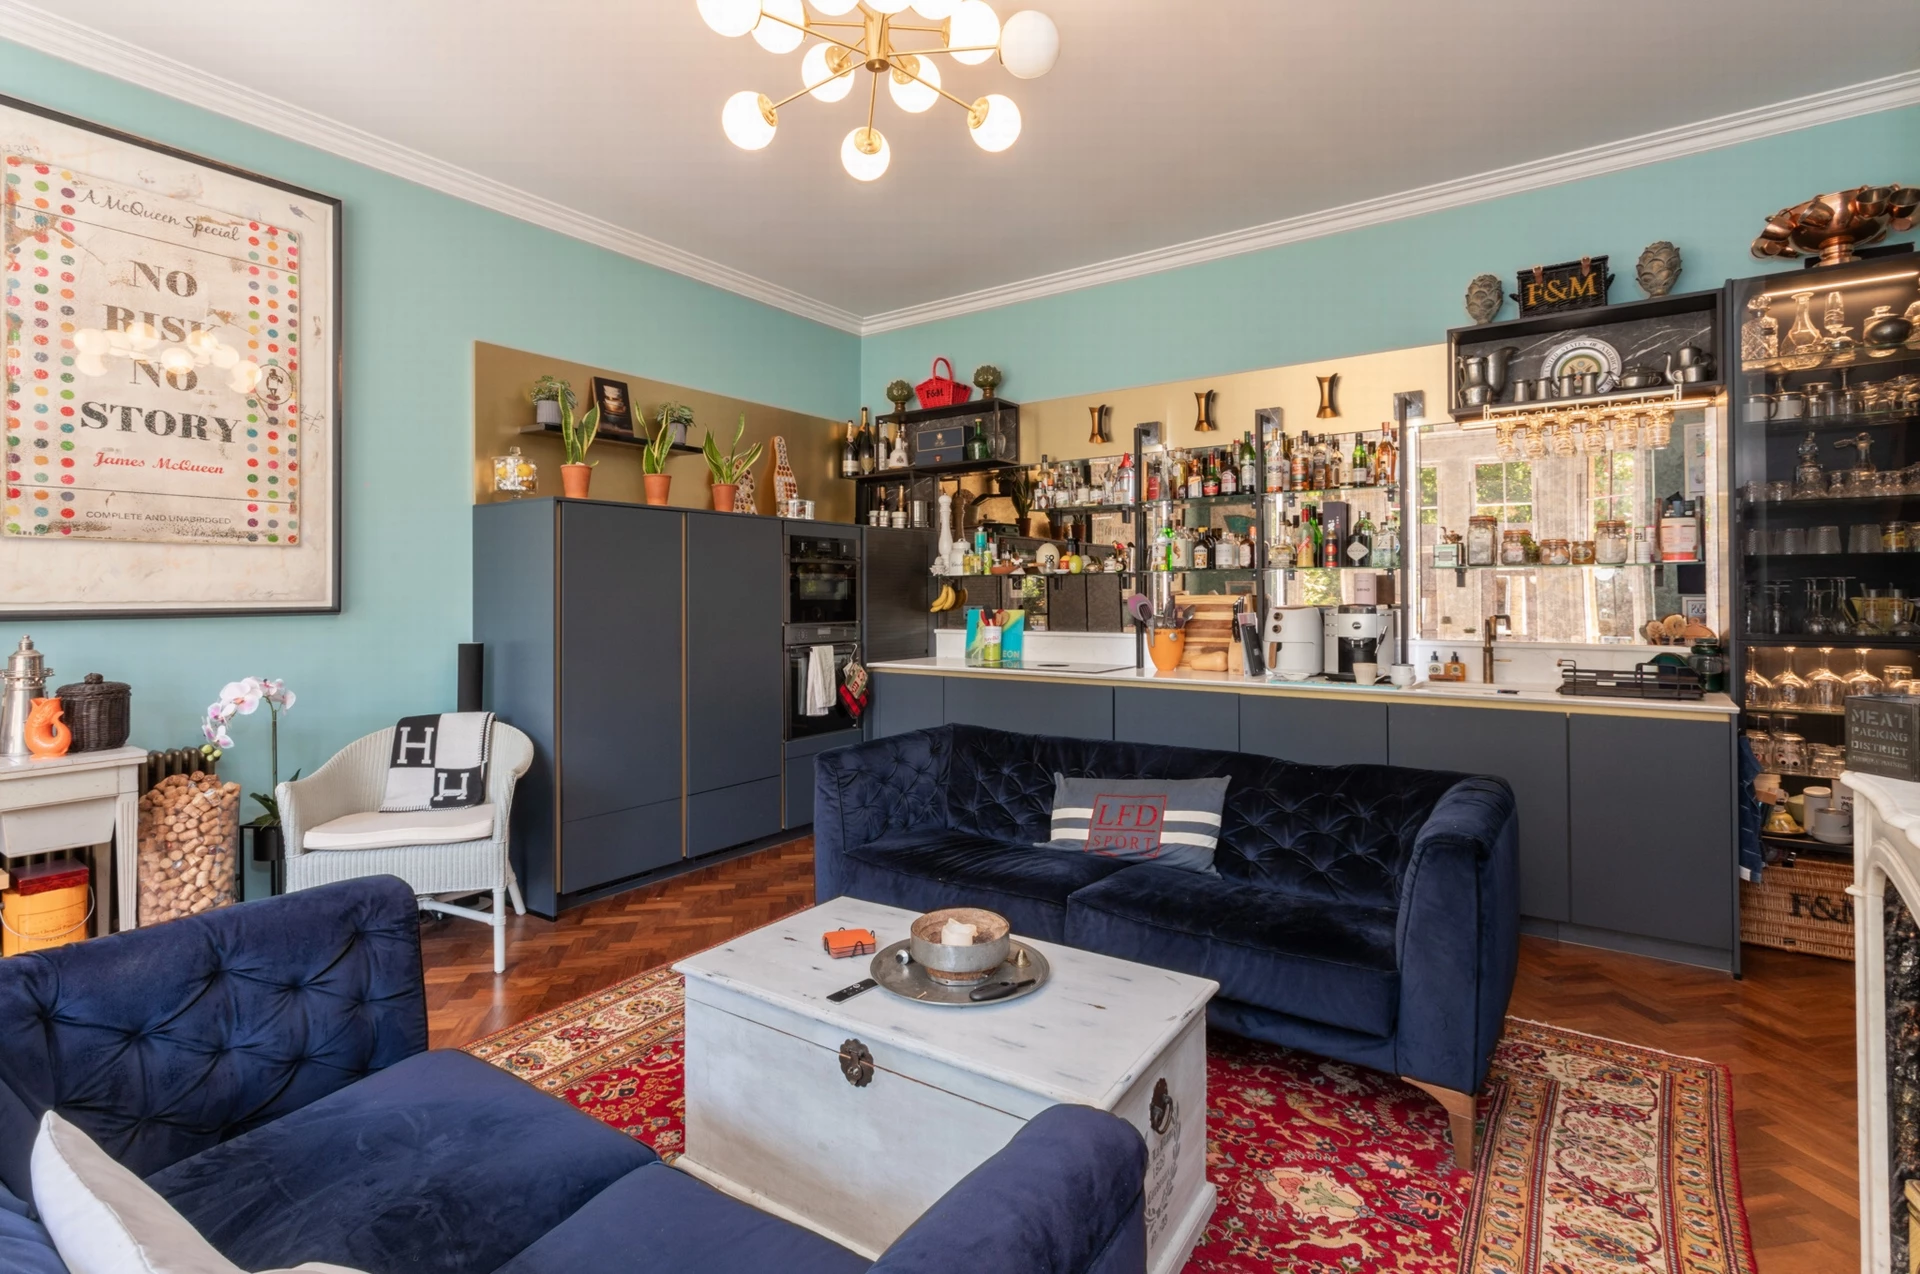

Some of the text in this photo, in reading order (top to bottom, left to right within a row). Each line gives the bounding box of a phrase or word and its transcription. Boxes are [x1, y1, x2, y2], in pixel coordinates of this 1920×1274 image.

[79, 189, 240, 241] A McQueen Special
[129, 260, 198, 297] NO
[1527, 273, 1597, 306] F&M
[102, 304, 221, 346] RISK
[128, 357, 198, 391] NO
[926, 387, 944, 399] F&M
[80, 401, 242, 444] STORY
[93, 451, 225, 475] James McQueen
[86, 511, 232, 525] COMPLETE AND UNABRIDGED
[1851, 709, 1909, 729] MEAT
[396, 727, 434, 764] H
[1851, 727, 1909, 743] PACKING
[1851, 740, 1909, 757] DISTRICT
[433, 772, 470, 801] H
[1096, 804, 1159, 828] LFD
[1093, 835, 1155, 851] SPORT
